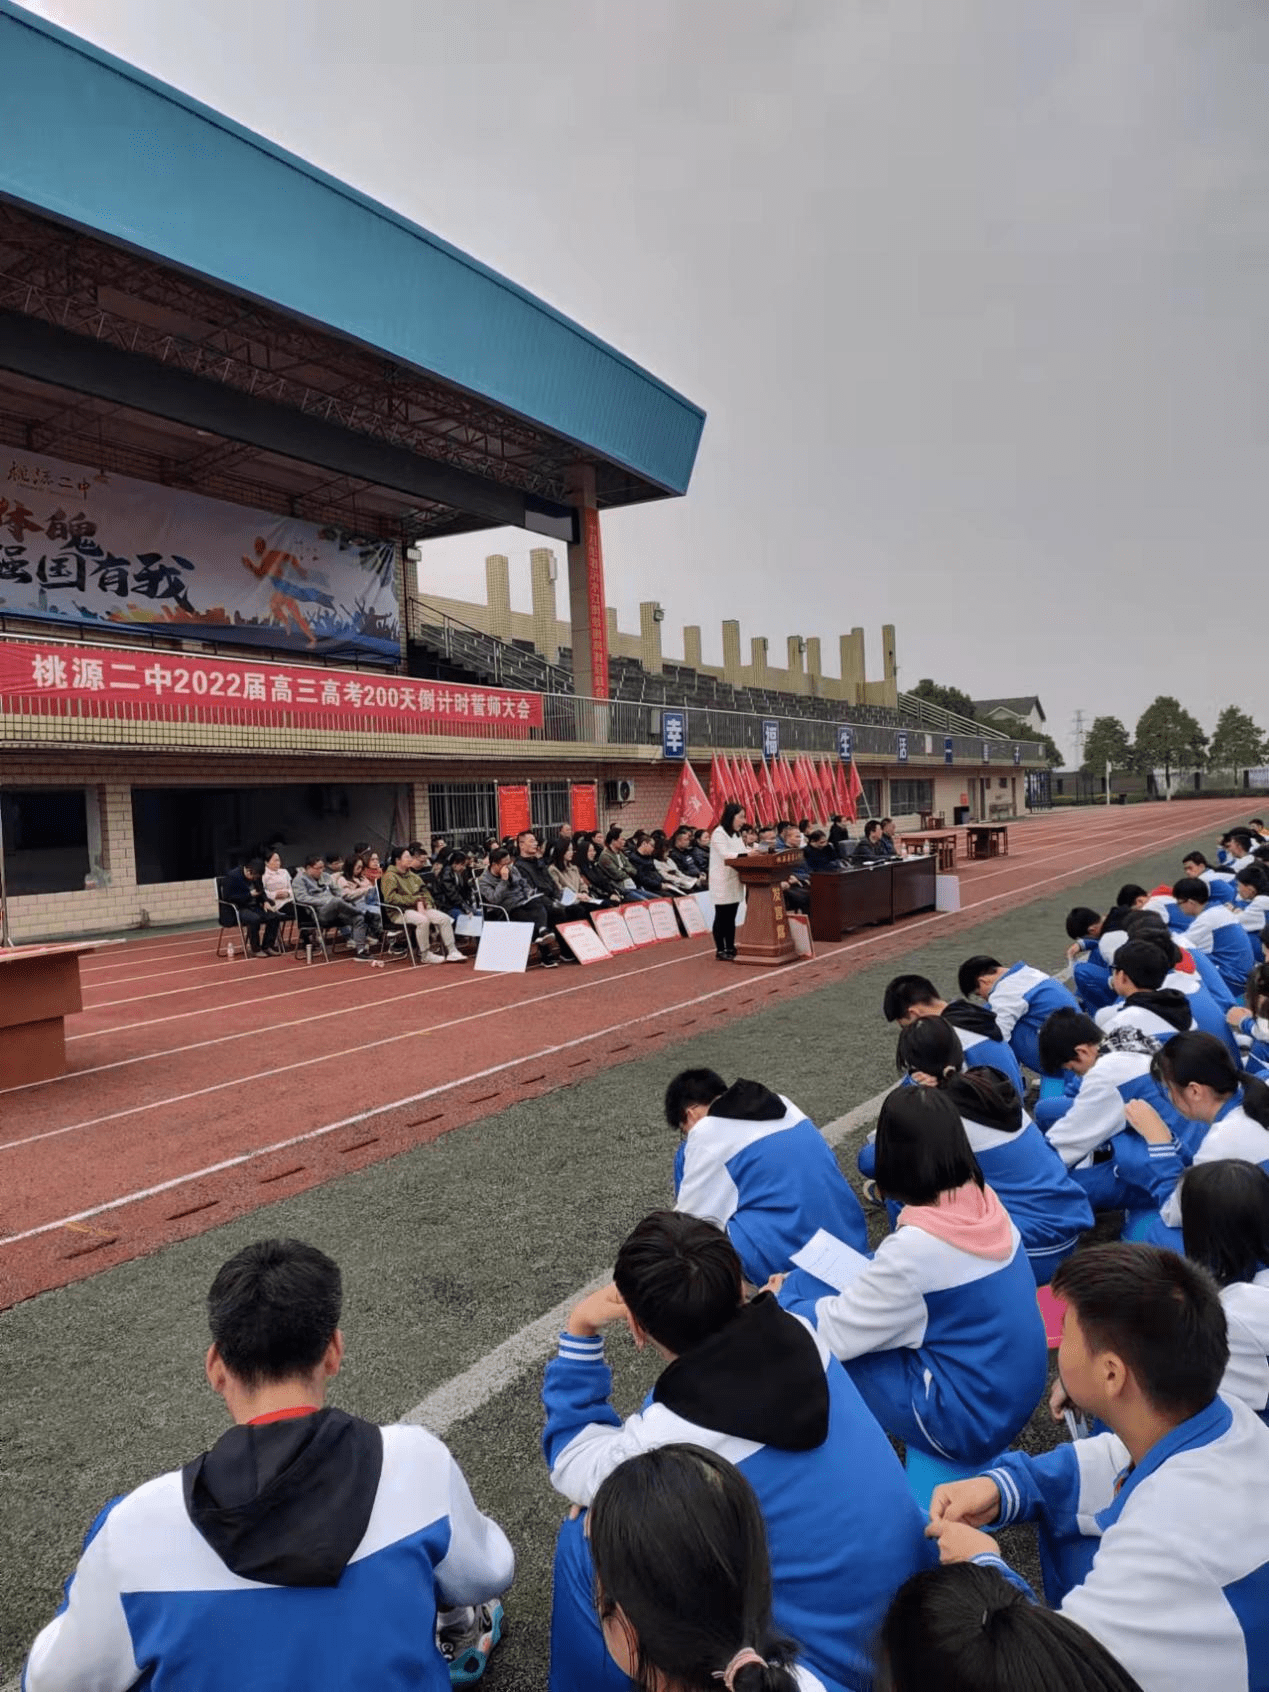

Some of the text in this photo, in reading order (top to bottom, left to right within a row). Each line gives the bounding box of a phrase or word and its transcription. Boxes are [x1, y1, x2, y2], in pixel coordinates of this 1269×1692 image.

[32, 654, 530, 720] 桃源二中2022届高三高考200天倒计时誓师大会
